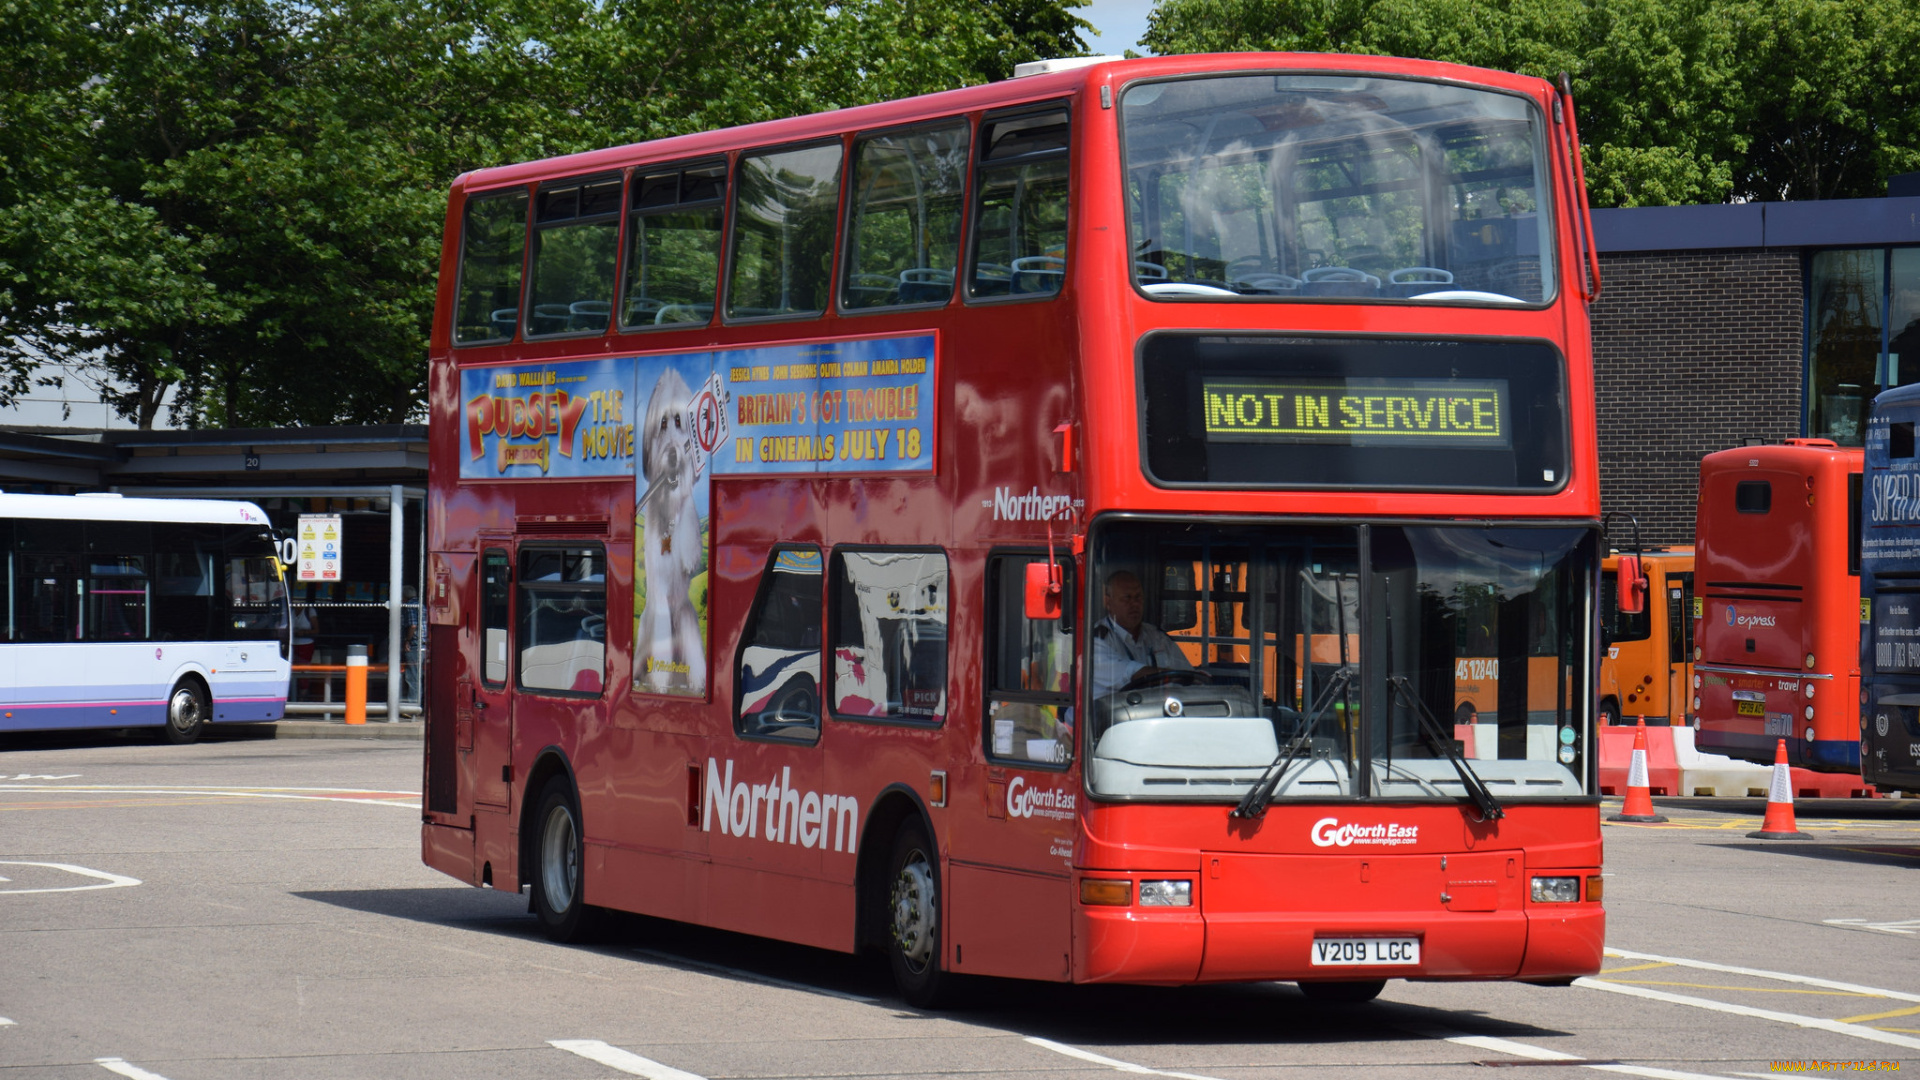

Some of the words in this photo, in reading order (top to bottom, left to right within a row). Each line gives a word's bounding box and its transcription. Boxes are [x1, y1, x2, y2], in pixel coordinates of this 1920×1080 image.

[496, 373, 517, 388] DAVID
[519, 371, 556, 387] WALLIAMS
[730, 366, 750, 383] JESSICA
[772, 365, 788, 380] JOHN
[790, 364, 817, 379] SESSIONS
[820, 362, 841, 378] OLIVIA
[843, 361, 868, 377] COLMAN
[871, 359, 899, 376] AMANDA
[901, 357, 926, 374] HOLDEN
[589, 389, 624, 423] THE
[718, 400, 726, 433] DOGS
[737, 391, 806, 425] BRITAIN'S
[810, 389, 842, 424] GOT
[846, 384, 919, 423] TROUBLE!
[1210, 394, 1284, 427] NOT
[1295, 395, 1329, 428] IN
[1339, 396, 1493, 430] SERVICE
[466, 389, 588, 461] PUDSEY
[689, 411, 701, 464] ALLOWED
[582, 424, 635, 460] MOVIE
[735, 437, 753, 463] IN
[759, 434, 835, 463] CINEMAS
[839, 429, 890, 461] JULY
[896, 427, 921, 460] 18
[246, 457, 259, 467] 20
[993, 486, 1070, 521] Northern
[1872, 474, 1909, 522] SUPER
[913, 692, 937, 702] PICK
[1738, 676, 1765, 688] smarter
[1778, 679, 1800, 691] travel
[703, 757, 858, 854] Northern
[1028, 786, 1054, 807] North
[1055, 788, 1076, 810] East
[1033, 808, 1075, 821] www.simplygo.com
[1345, 823, 1386, 838] North
[1387, 823, 1419, 838] East
[1353, 838, 1417, 847] www.simplygo.com
[1317, 941, 1367, 961] V209
[1376, 941, 1413, 961] LGC
